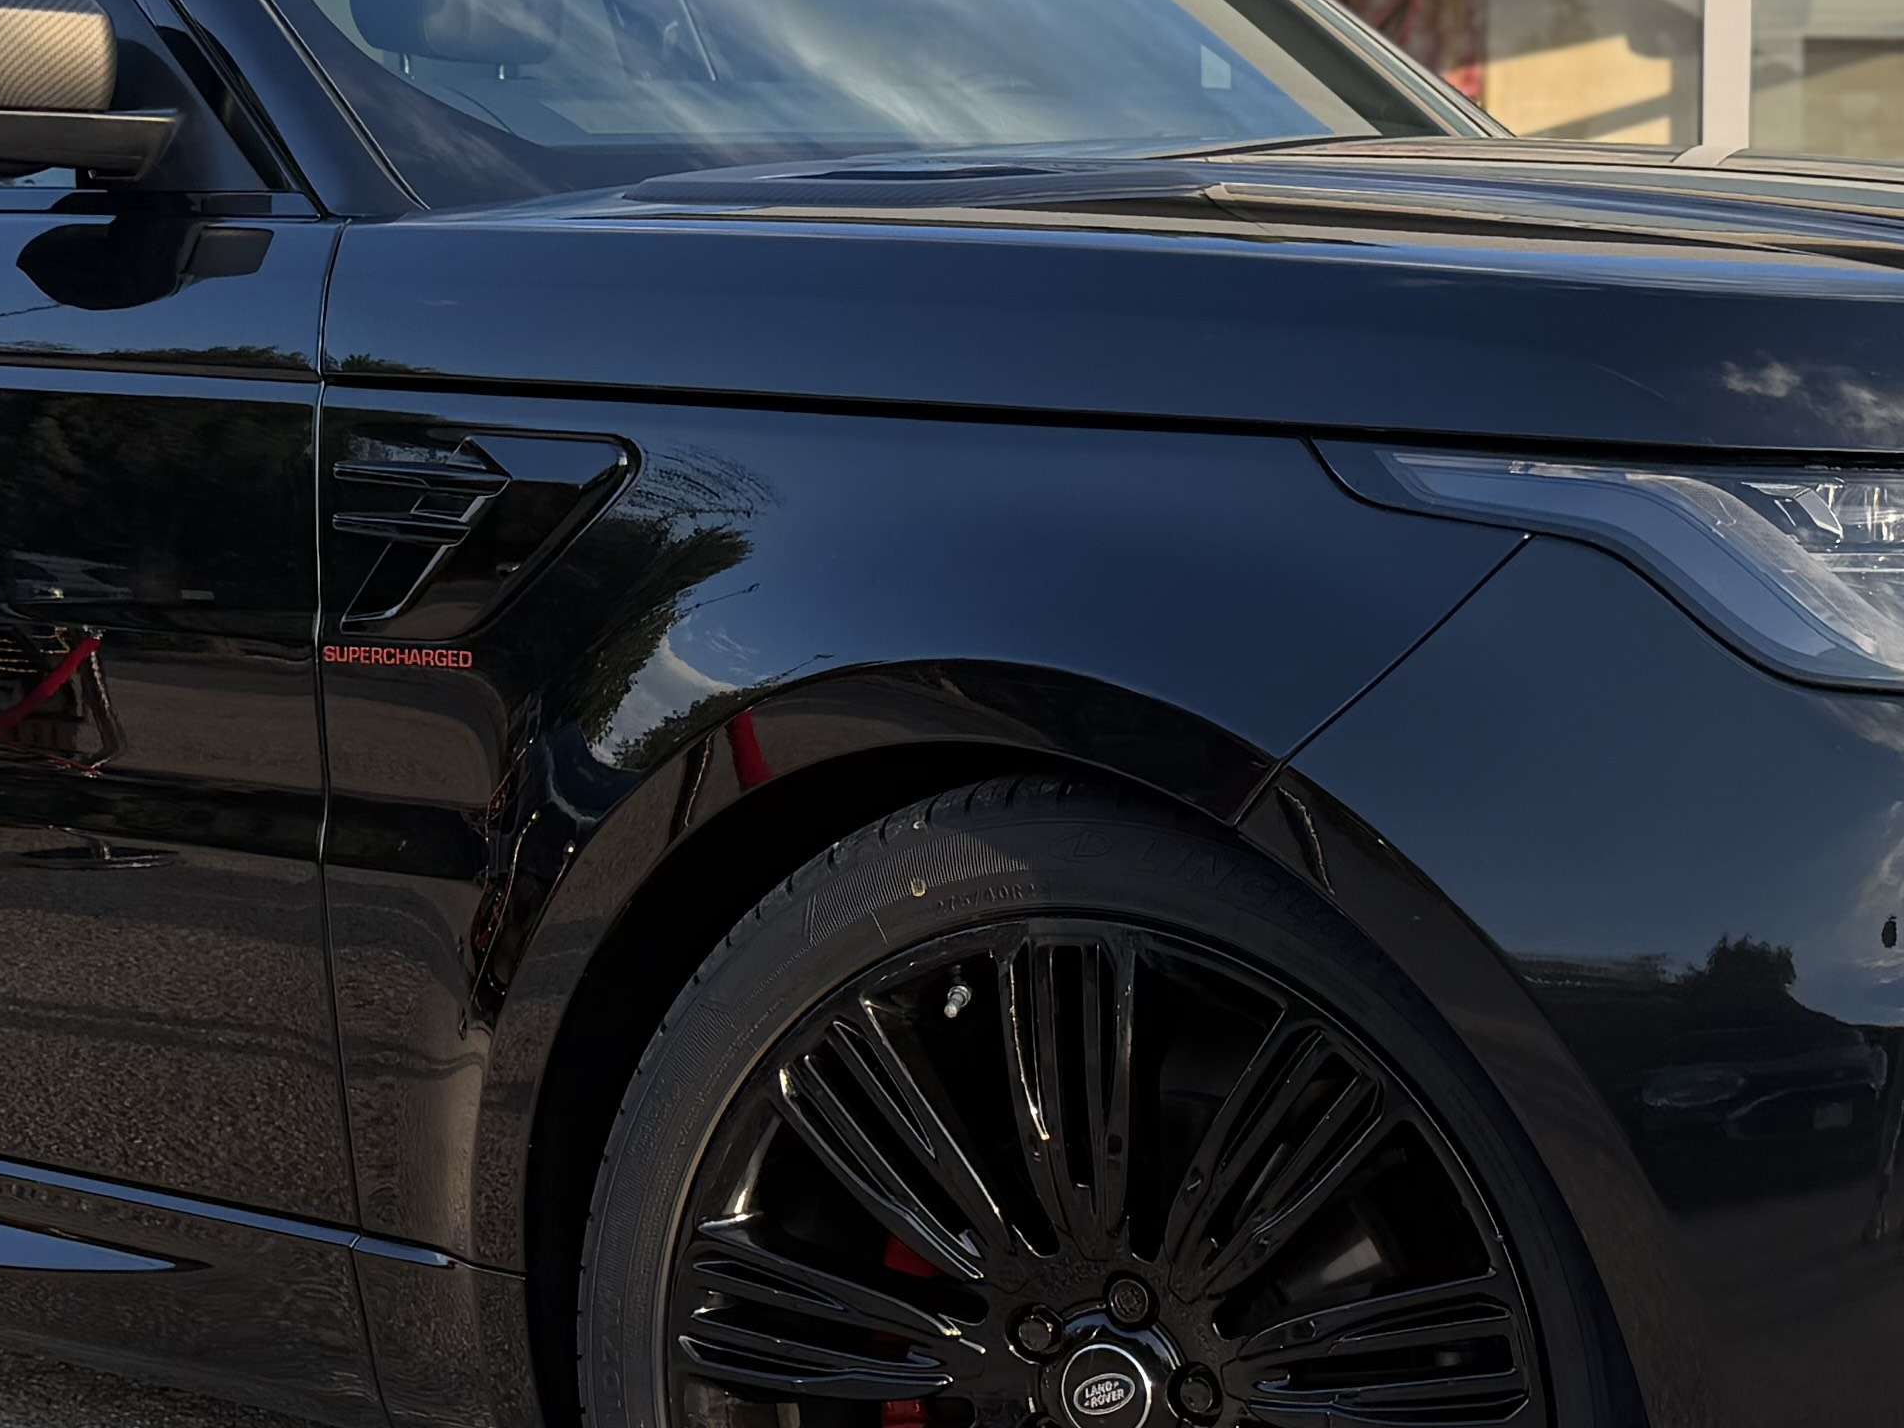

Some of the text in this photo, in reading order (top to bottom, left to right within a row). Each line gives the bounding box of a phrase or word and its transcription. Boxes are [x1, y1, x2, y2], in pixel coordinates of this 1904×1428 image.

[323, 645, 473, 668] SUPERCHARGED
[1085, 1380, 1112, 1398] LAND
[1090, 1388, 1124, 1408] ROVER
